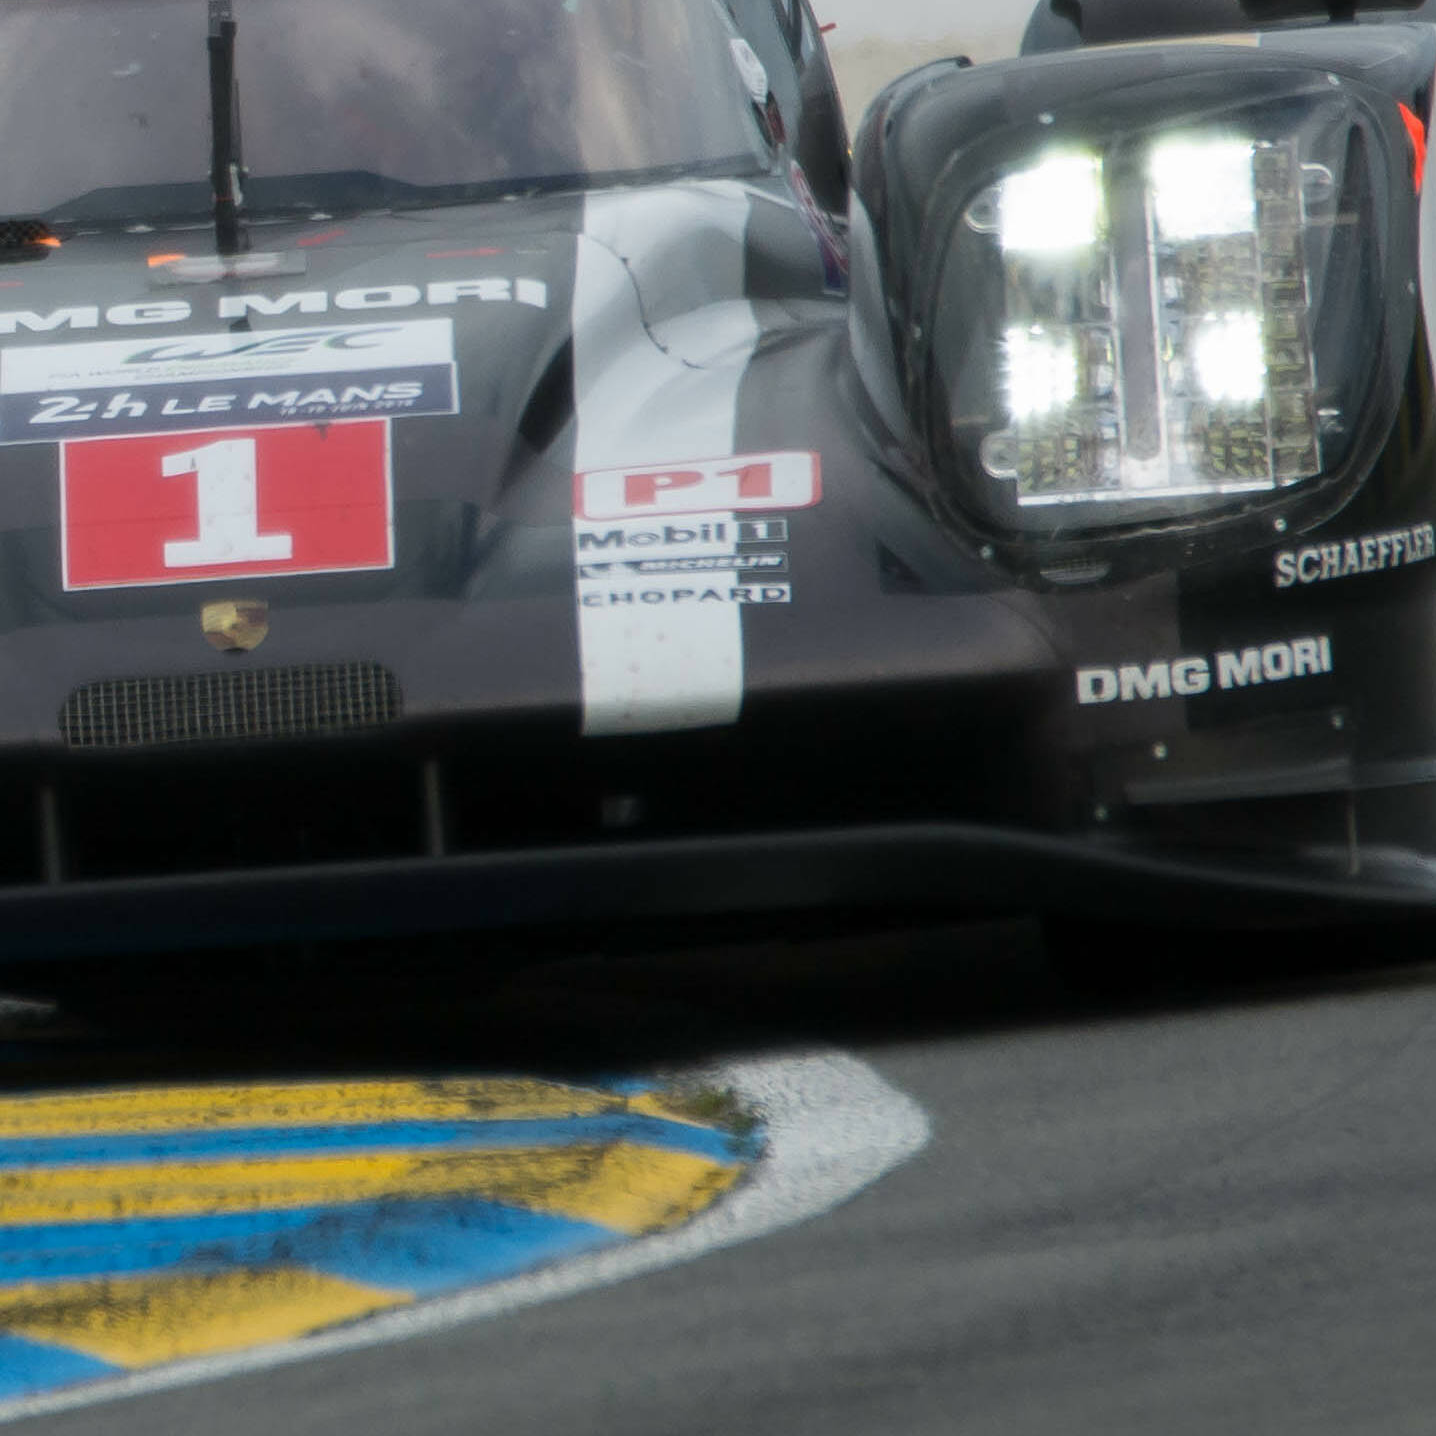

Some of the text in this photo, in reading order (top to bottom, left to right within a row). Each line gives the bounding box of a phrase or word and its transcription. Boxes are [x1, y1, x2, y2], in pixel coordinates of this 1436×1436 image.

[218, 277, 549, 320] MORI
[122, 326, 406, 365] WEC
[160, 394, 237, 417] LE
[246, 381, 424, 411] MANS
[161, 438, 293, 569] 1
[623, 462, 773, 507] P1
[578, 522, 727, 552] Mobil
[1274, 521, 1436, 589] SCHAEFFLER
[582, 585, 787, 608] CHOPARD
[1076, 634, 1333, 705] DMG MORI
